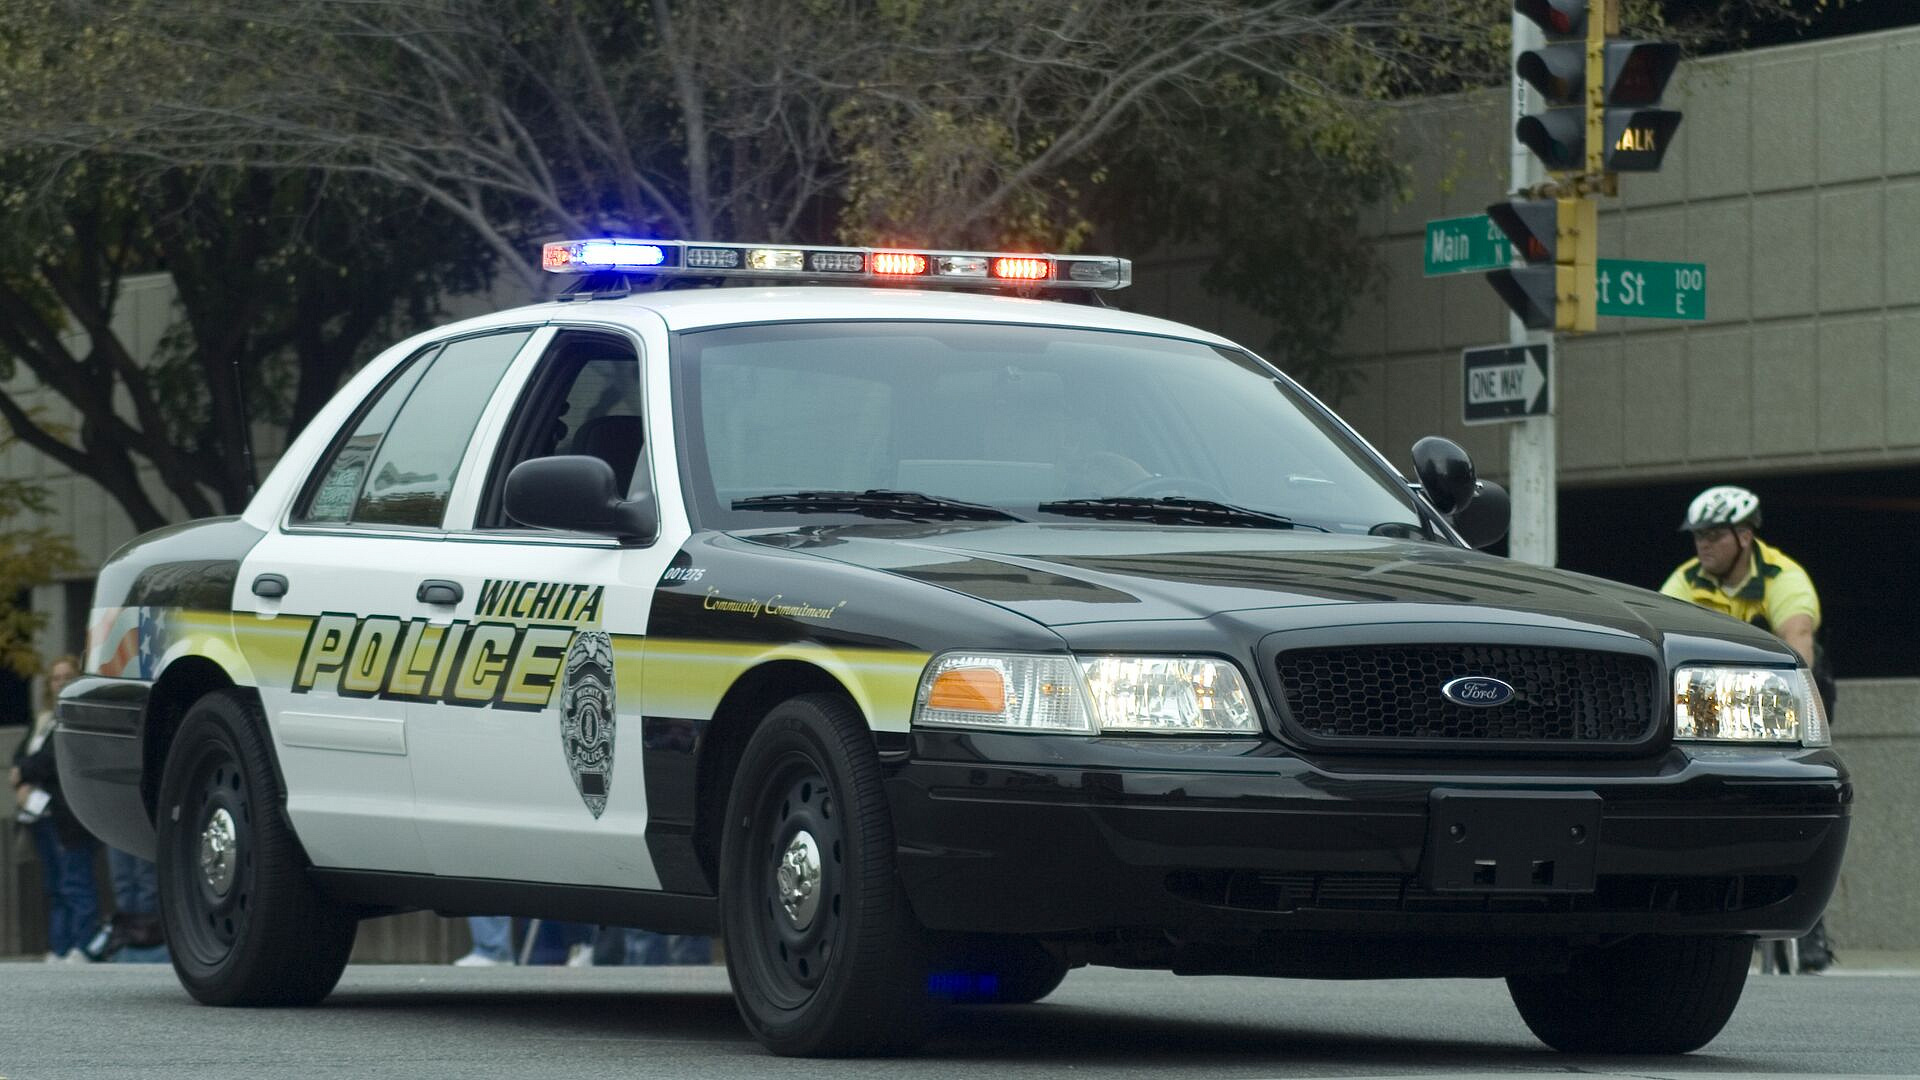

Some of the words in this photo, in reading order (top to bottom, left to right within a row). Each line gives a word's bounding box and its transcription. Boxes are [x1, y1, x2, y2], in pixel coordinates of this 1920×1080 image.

[1615, 127, 1655, 151] ALK
[1487, 217, 1508, 240] 20
[1431, 228, 1470, 264] Main
[1619, 271, 1646, 305] St
[1675, 269, 1702, 290] 100
[1676, 293, 1686, 314] E
[1472, 371, 1497, 399] ONE
[1501, 368, 1525, 396] WAY
[663, 567, 706, 581] 001275
[475, 579, 605, 622] WICHITA
[291, 611, 578, 713] POLICE
[1461, 682, 1498, 699] Ford
[577, 745, 605, 763] POLICE
